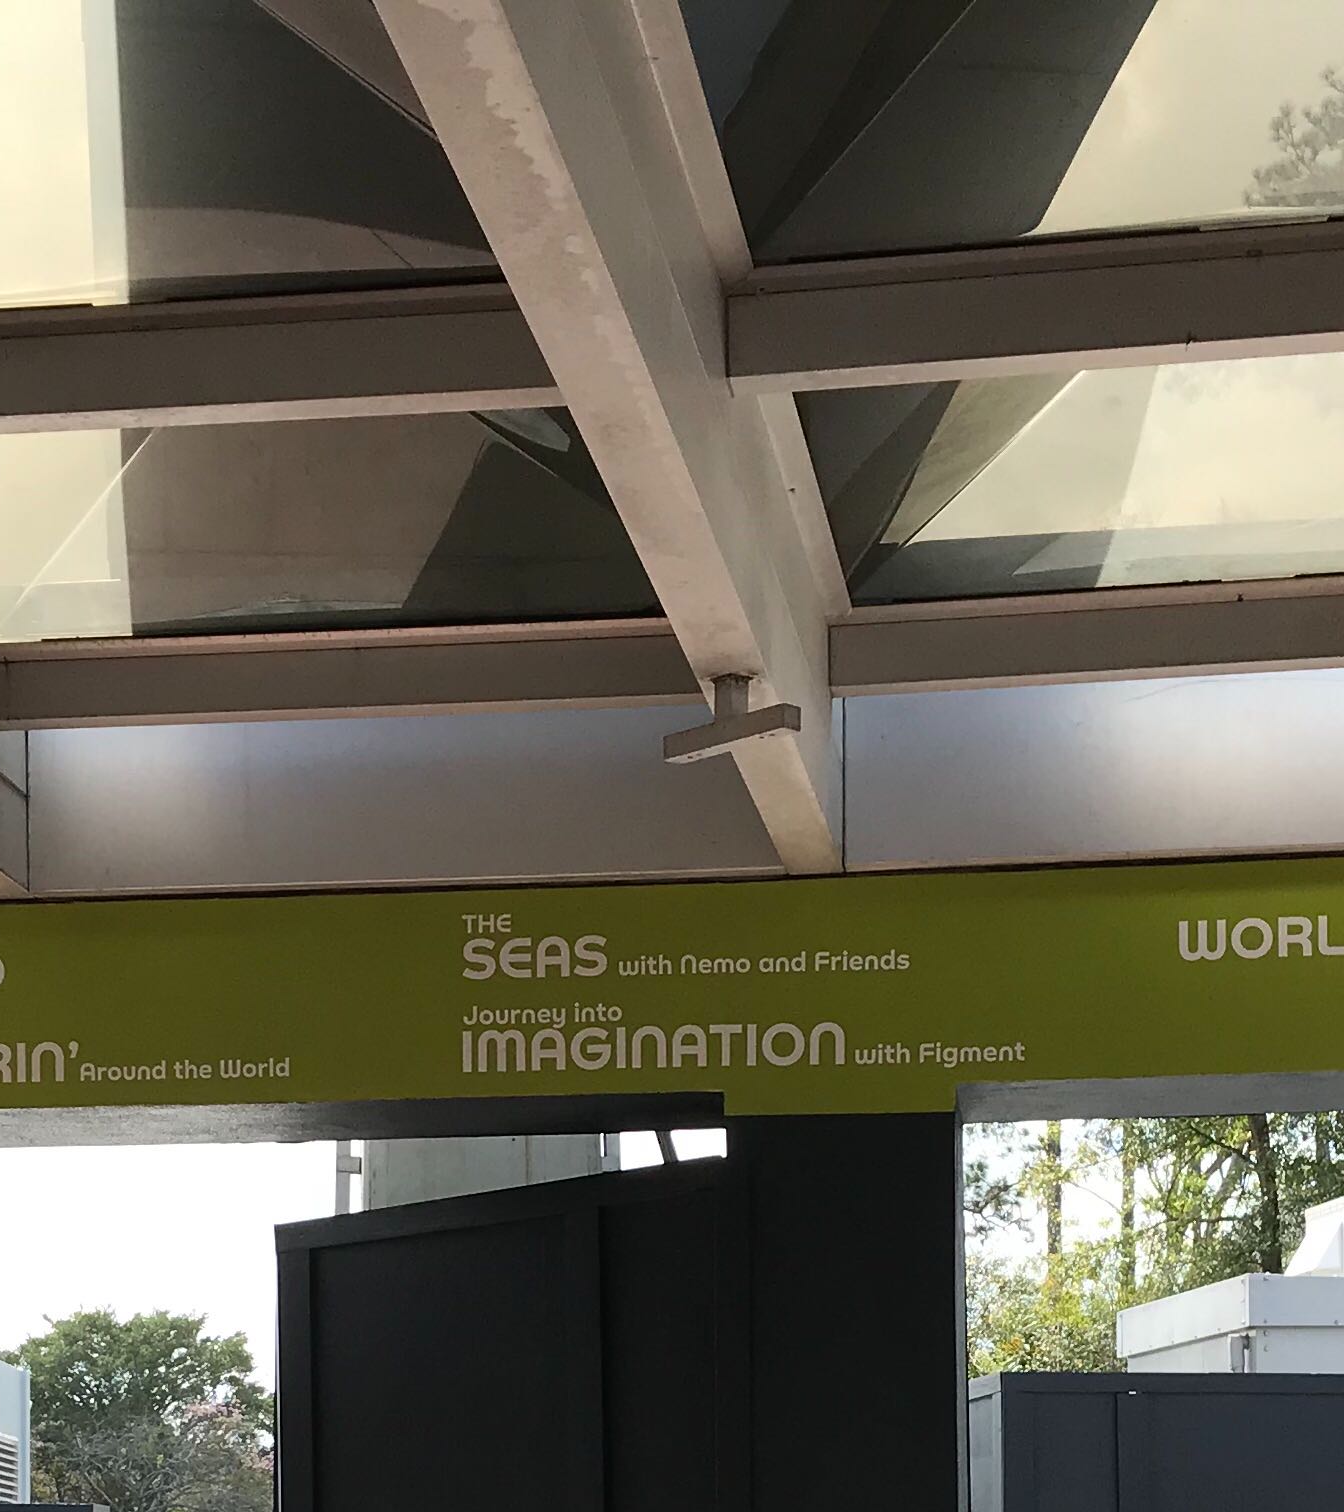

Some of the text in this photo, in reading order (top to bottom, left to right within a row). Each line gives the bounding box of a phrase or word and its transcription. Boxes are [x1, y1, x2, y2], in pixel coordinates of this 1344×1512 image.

[462, 914, 512, 934] THE
[462, 935, 911, 980] SEAS with Nemo and Friends
[463, 1003, 623, 1029] Journey into
[462, 1021, 1026, 1073] IMAGINATION with Figment
[80, 1060, 167, 1082] Around
[173, 1059, 212, 1080] the
[220, 1057, 290, 1079] World
